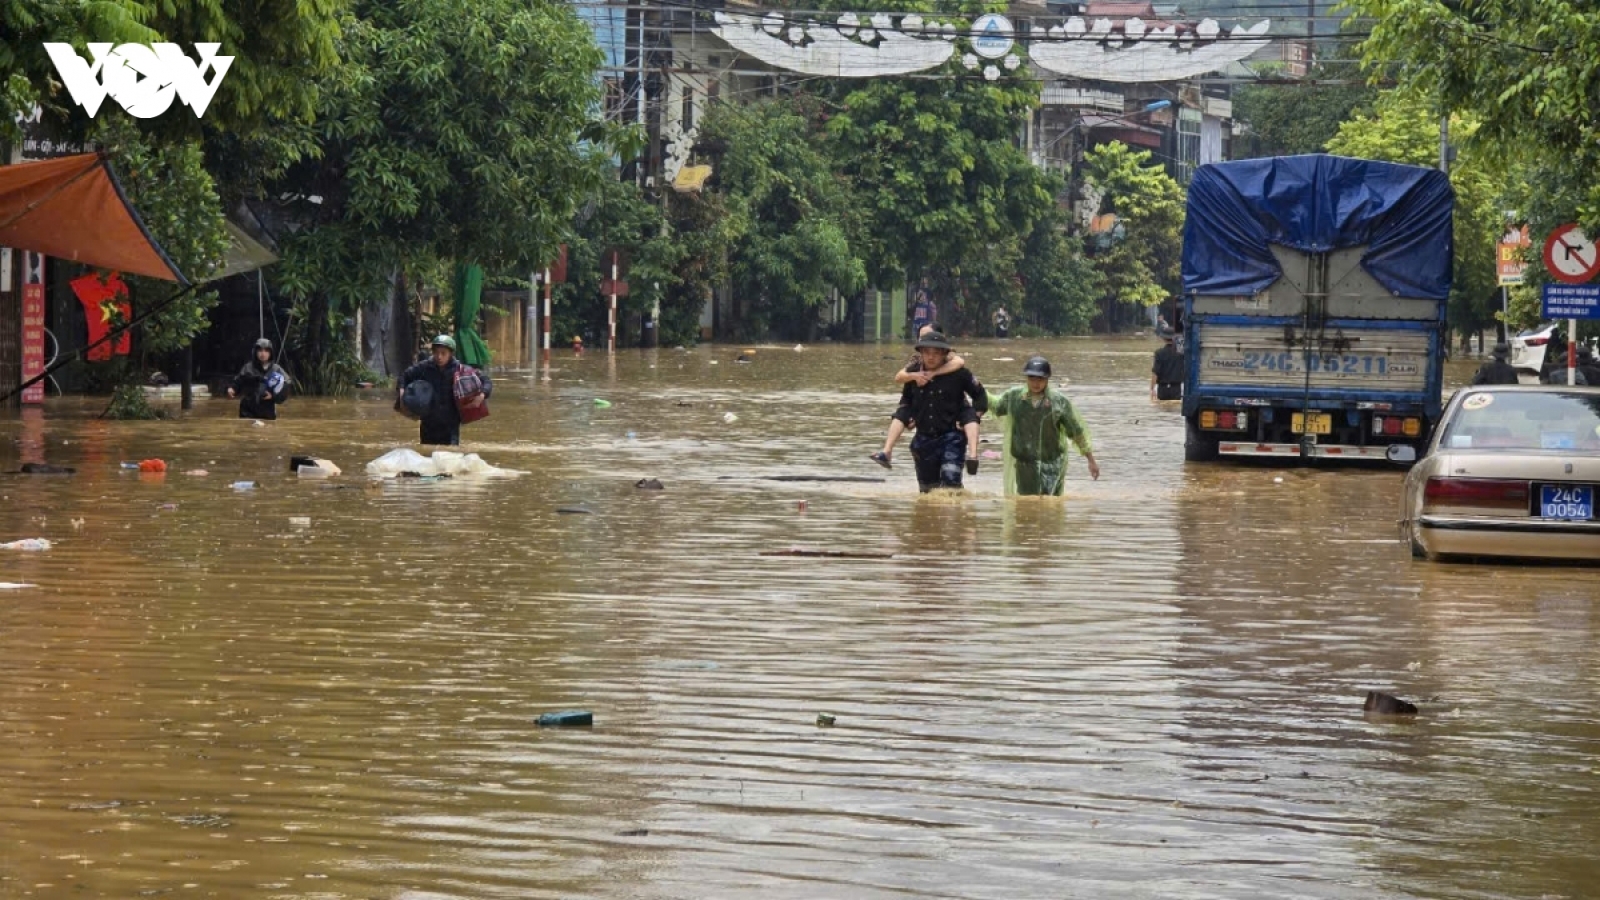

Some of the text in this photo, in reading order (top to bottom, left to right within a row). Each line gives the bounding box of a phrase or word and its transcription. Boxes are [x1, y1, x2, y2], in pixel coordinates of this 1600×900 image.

[1211, 360, 1244, 368] THACO
[1295, 423, 1326, 433] 0211
[1551, 487, 1582, 503] 24C
[1547, 503, 1587, 517] 0054
